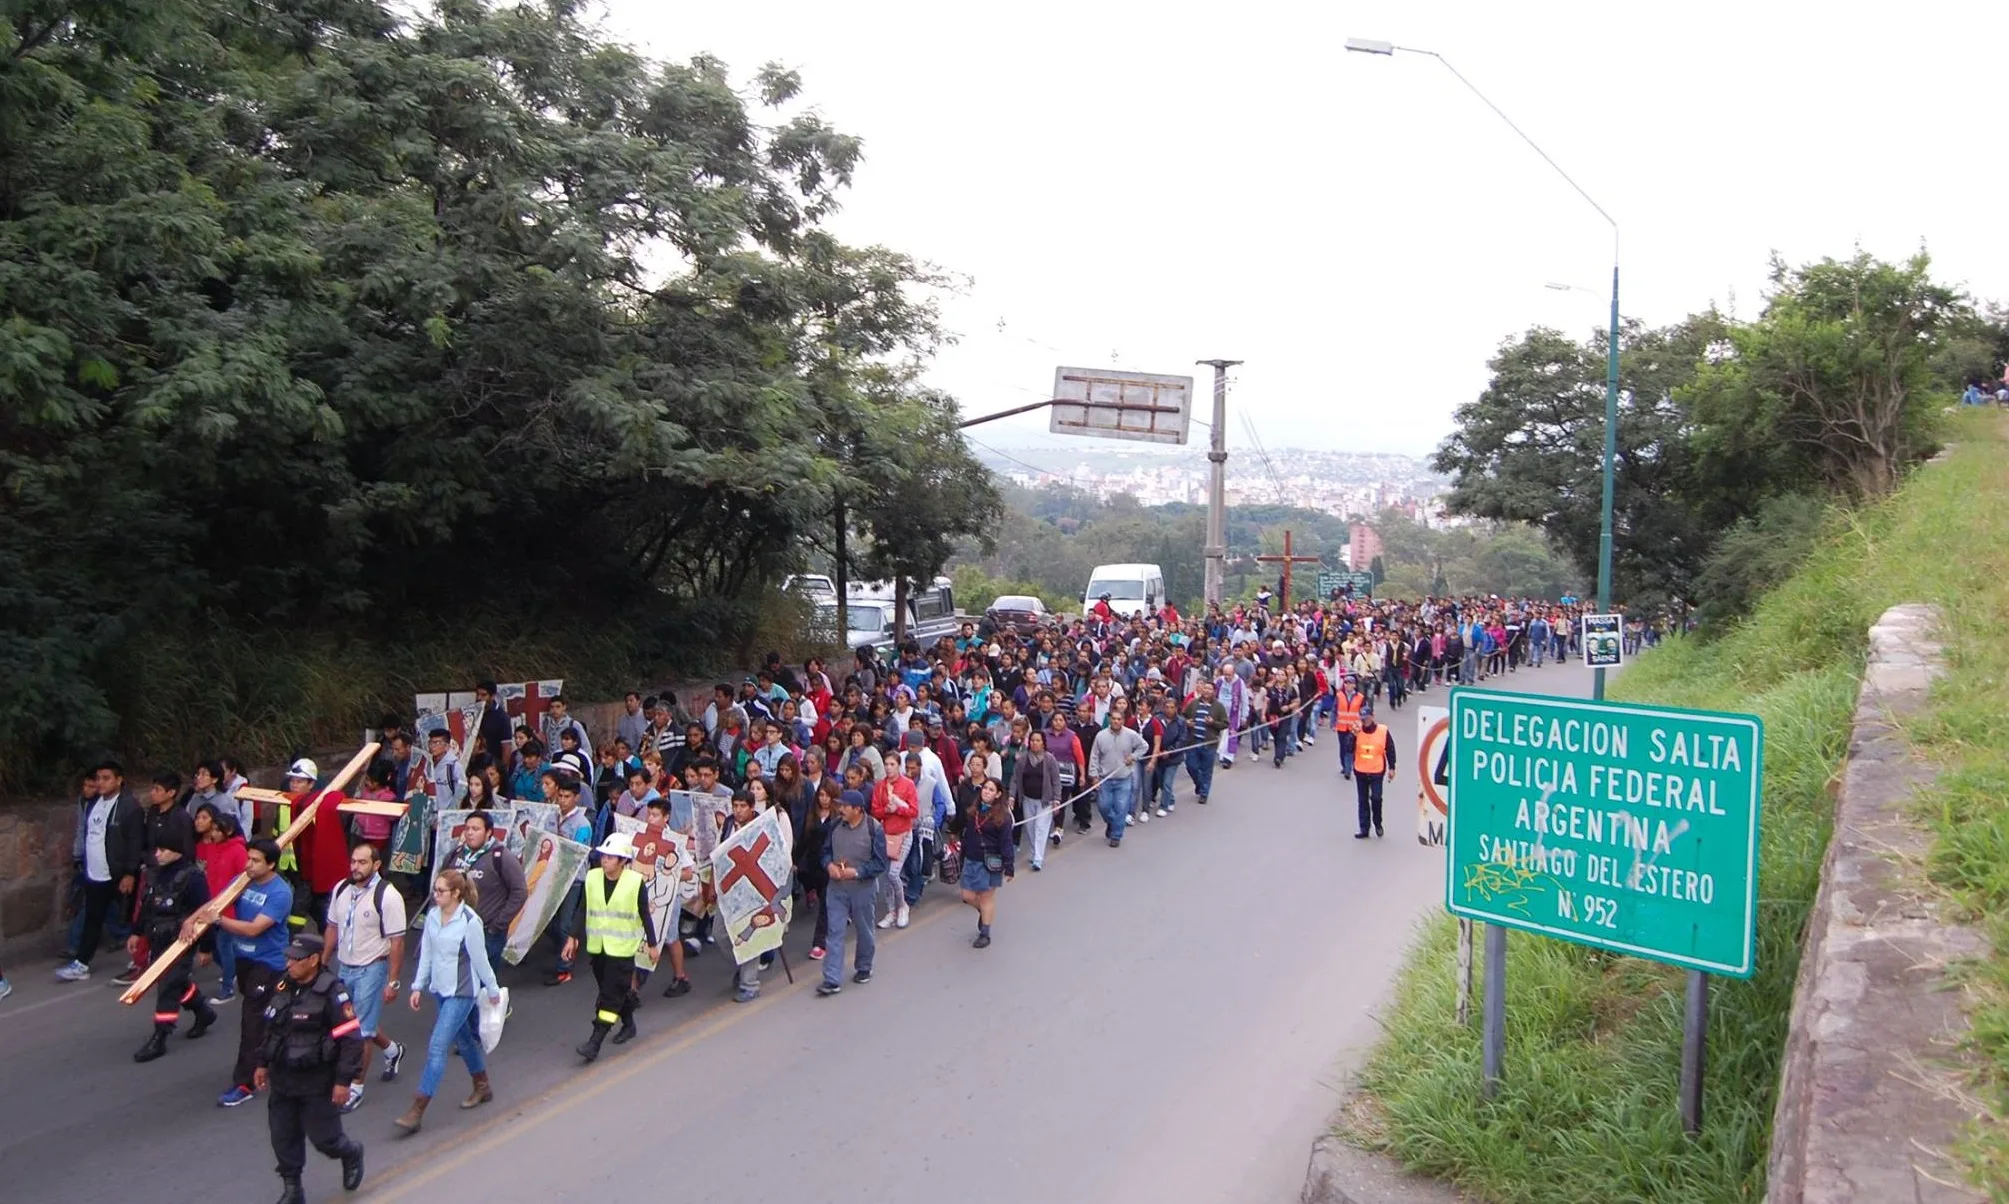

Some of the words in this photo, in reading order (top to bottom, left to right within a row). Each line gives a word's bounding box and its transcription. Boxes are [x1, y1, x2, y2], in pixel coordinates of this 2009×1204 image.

[1464, 708, 1628, 759] DELEGACION
[1648, 729, 1741, 772] SALTA
[1473, 750, 1578, 794] POLICIA
[1590, 765, 1726, 816] FEDERAL
[1429, 820, 1448, 846] M
[1514, 798, 1672, 854] ARGENTINA
[1478, 834, 1577, 877] SANTIAGO
[1587, 854, 1622, 888] DEL
[1633, 863, 1714, 904] ESTERO
[1584, 895, 1618, 929] 952
